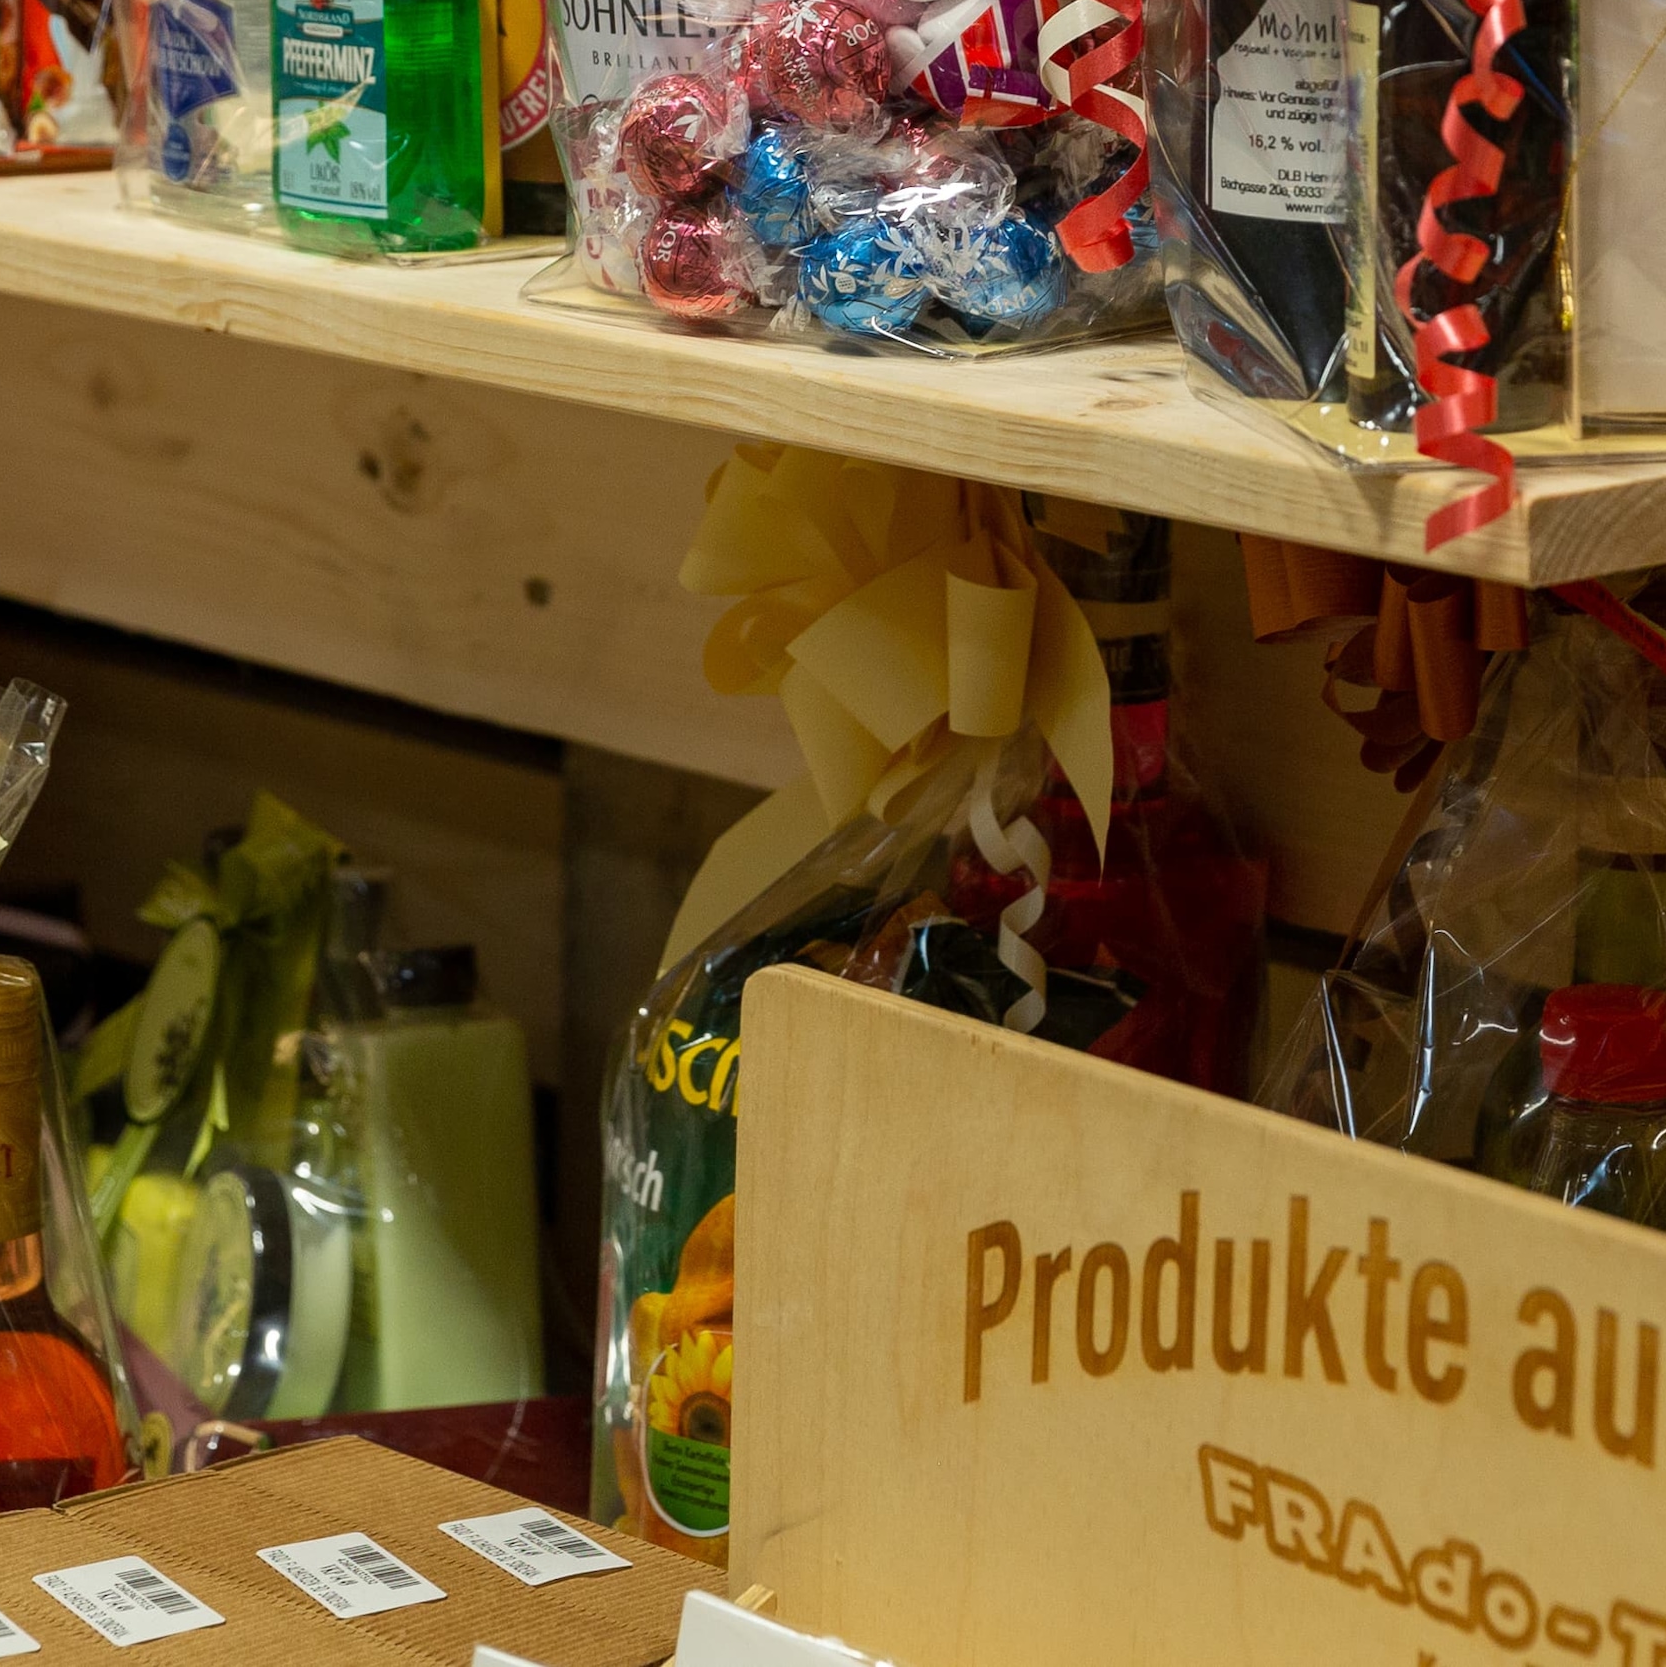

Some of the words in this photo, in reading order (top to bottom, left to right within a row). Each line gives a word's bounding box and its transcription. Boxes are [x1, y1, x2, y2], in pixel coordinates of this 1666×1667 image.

[282, 36, 376, 85] PFEFFERMINZ
[591, 50, 693, 72] BRILLANT
[1266, 107, 1286, 120] und
[963, 1188, 1471, 1405] Produkte
